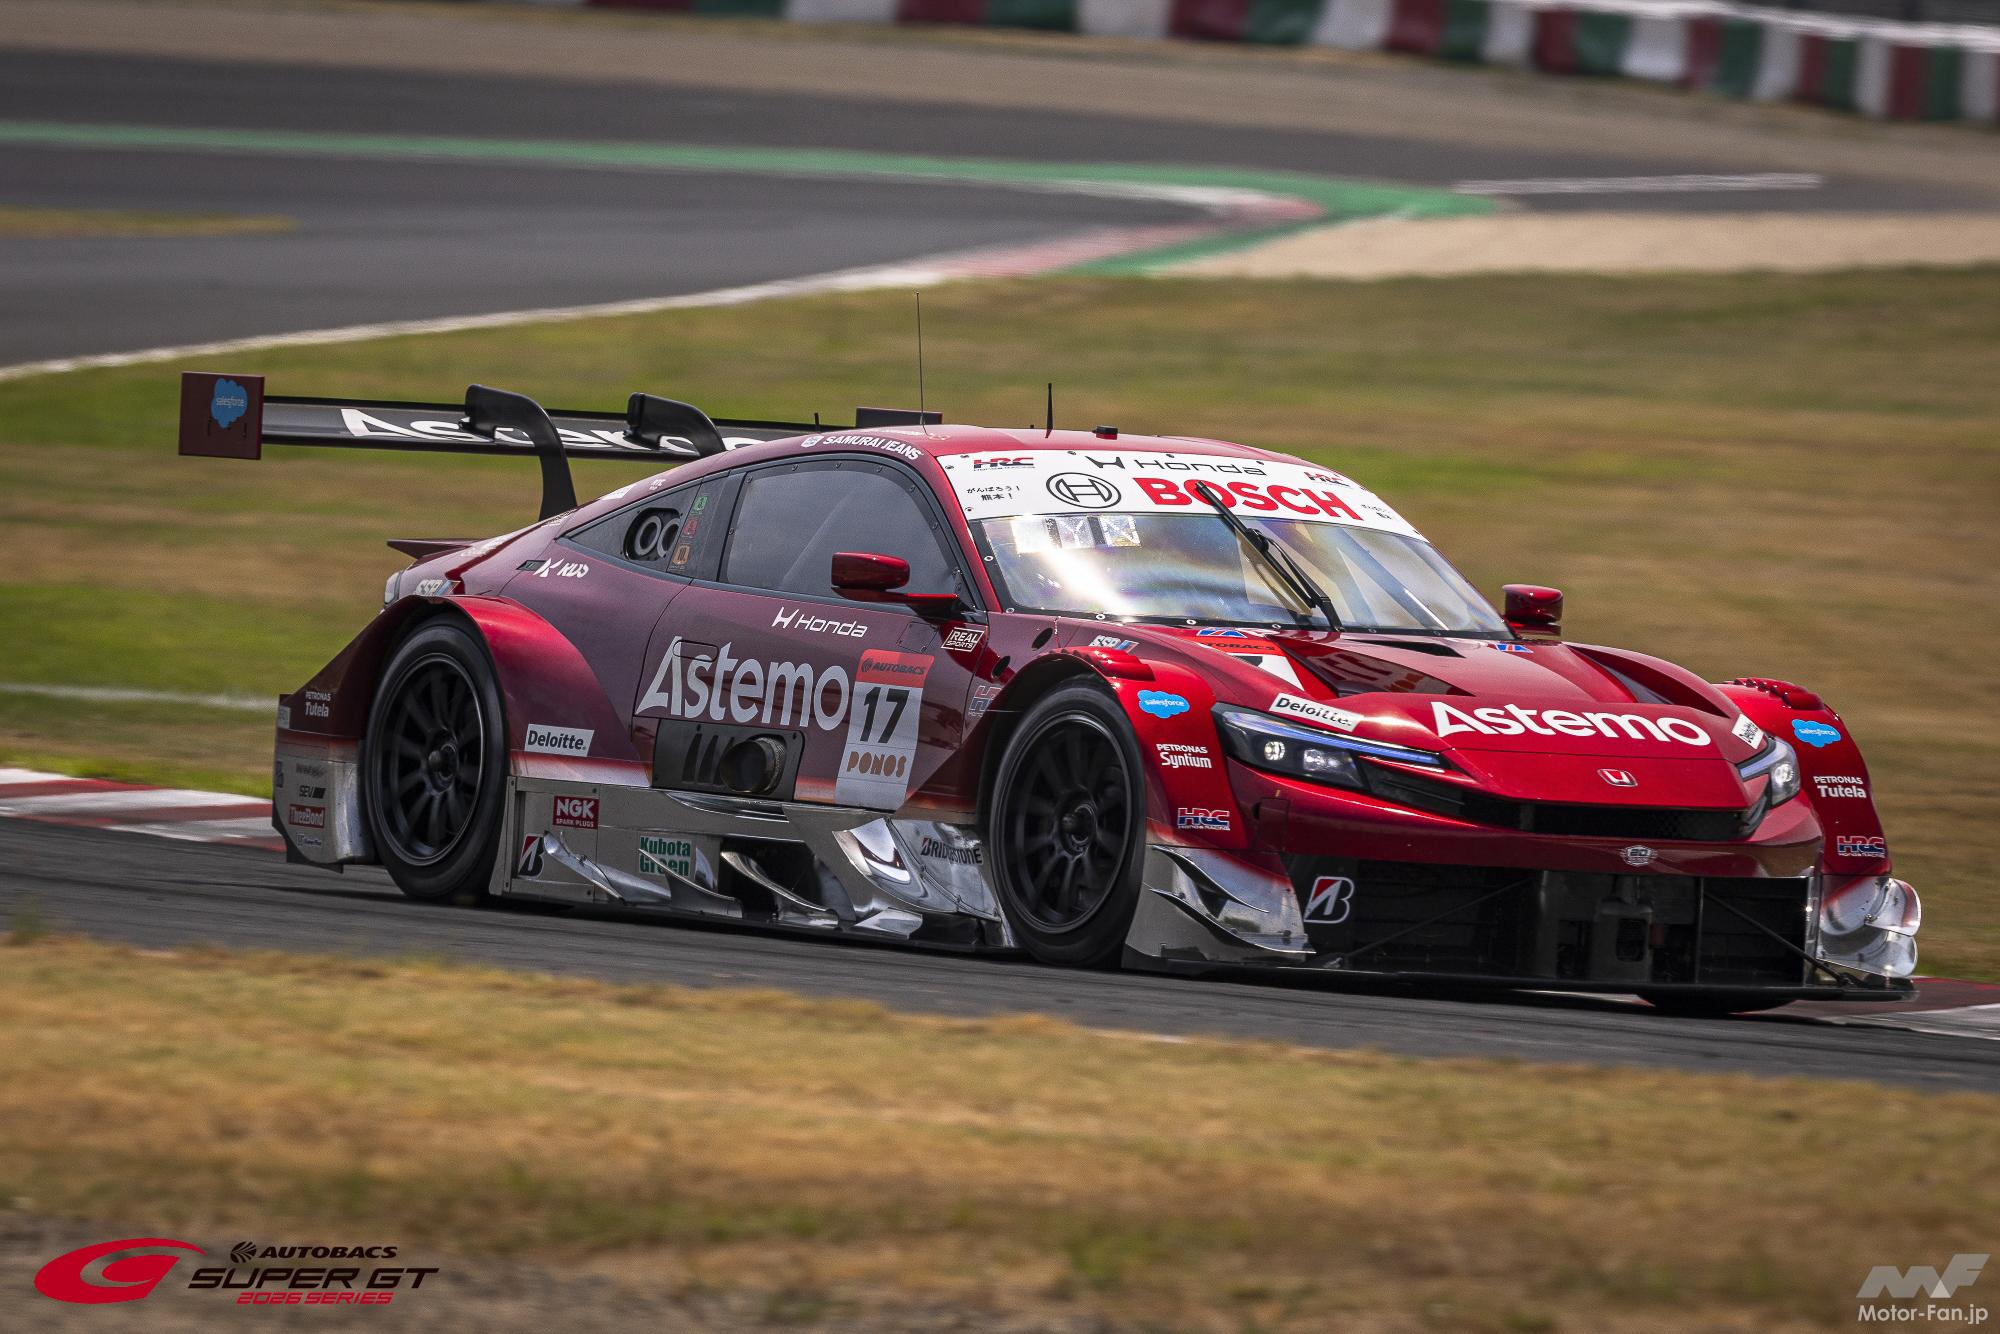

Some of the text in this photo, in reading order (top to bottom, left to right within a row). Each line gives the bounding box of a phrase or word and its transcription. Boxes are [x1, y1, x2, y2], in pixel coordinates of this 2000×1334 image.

[822, 435, 884, 448] SAMURAI
[881, 440, 922, 461] JEANS
[973, 457, 1035, 470] HRC
[1134, 459, 1267, 477] Honda
[1133, 477, 1365, 521] BOSCH
[794, 613, 868, 638] Honda
[951, 627, 978, 643] REAL
[946, 640, 974, 649] SPORTS
[872, 661, 925, 676] AUTOBACS
[634, 635, 850, 731] Astemo
[305, 691, 331, 701] PETRONAS
[1144, 698, 1185, 708] salesforce
[304, 702, 330, 718] Tutela
[859, 686, 911, 744] 17
[1430, 701, 1712, 746] Astemo
[1799, 728, 1837, 737] salesforce
[1156, 743, 1209, 754] PETRONAS
[847, 751, 907, 778] PONOS
[1160, 752, 1213, 769] Syntium
[1813, 775, 1864, 785] PETRONAS
[1816, 785, 1867, 799] Tutela
[290, 807, 325, 827] ThreeBond
[556, 799, 595, 819] NGK
[1177, 807, 1230, 826] HRC
[556, 818, 595, 828] SPARK PLUGS
[639, 835, 692, 857] Kubota
[1836, 835, 1886, 854] HRC
[639, 853, 690, 877] Green
